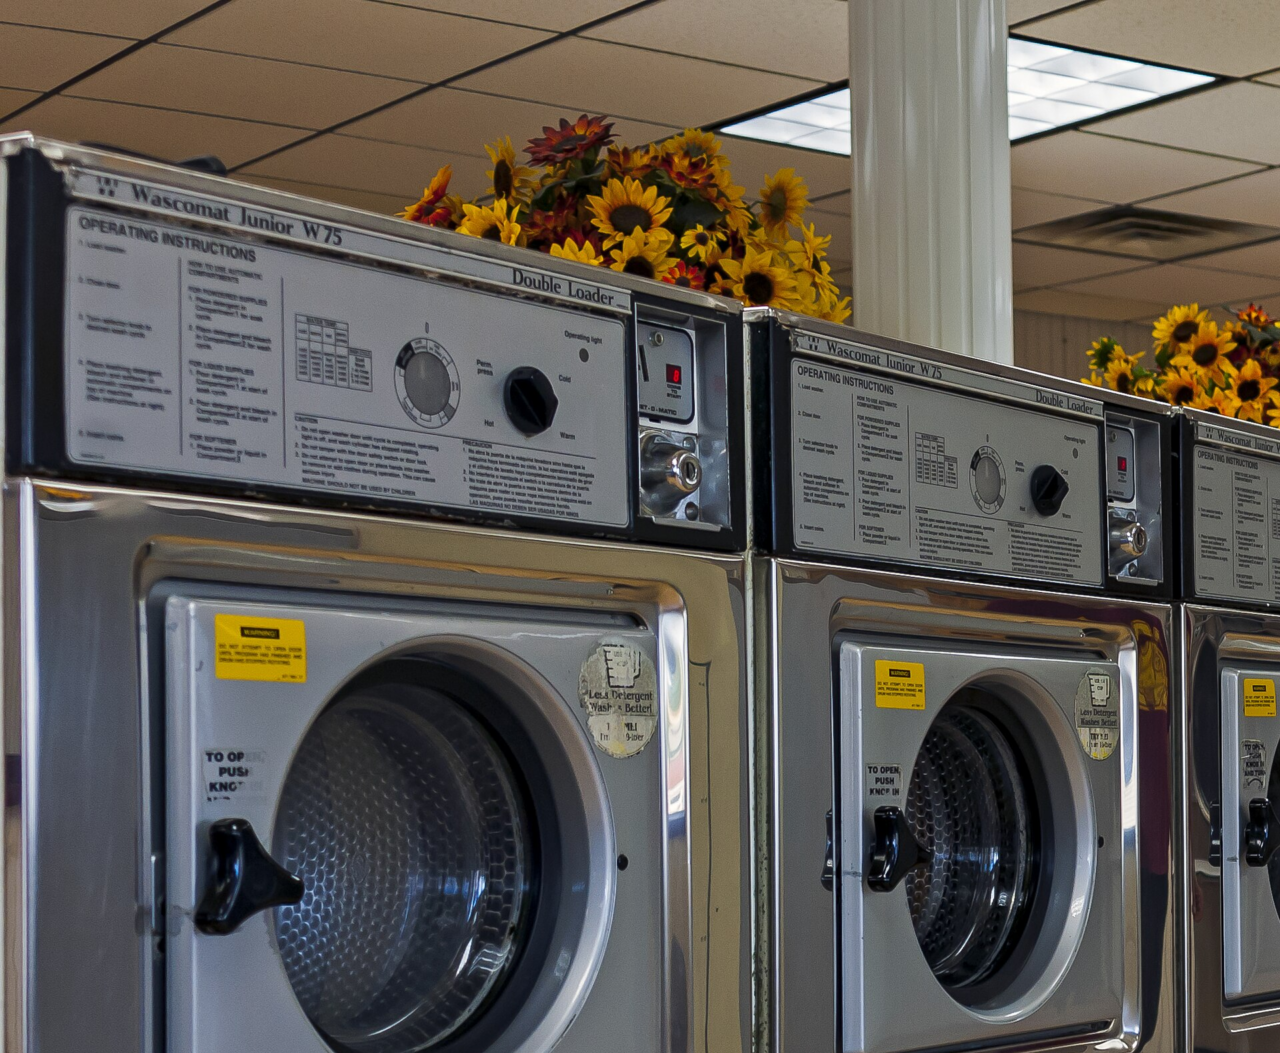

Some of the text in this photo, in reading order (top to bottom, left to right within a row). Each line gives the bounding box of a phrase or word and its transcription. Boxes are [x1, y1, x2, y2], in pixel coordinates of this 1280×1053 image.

[132, 184, 230, 222] Wascomat
[240, 206, 293, 236] Junior
[79, 216, 256, 262] OPERATING INSTRUCTIONS
[512, 268, 615, 305] Double Loader
[564, 330, 602, 345] Operating light
[826, 341, 881, 367] Wascomat
[886, 354, 915, 374] Junior
[476, 359, 493, 369] Perm.
[477, 367, 493, 377] press
[558, 374, 571, 383] Cold
[797, 365, 894, 395] OPERATING INSTRUCTIONS
[1036, 390, 1093, 415] Double Loader
[484, 419, 494, 427] Hot
[560, 432, 575, 440] Warm
[1217, 430, 1251, 447] Wascomat
[1254, 438, 1273, 452] Junior
[1197, 450, 1258, 470] OPERATING INSTRUCTIONS
[589, 690, 653, 702] Less Detergent
[589, 702, 622, 713] Washs
[1093, 709, 1117, 718] Detergent
[206, 752, 224, 762] TO
[868, 766, 899, 774] TO OPEN
[209, 781, 245, 792] KNO
[875, 777, 894, 785] PUSH
